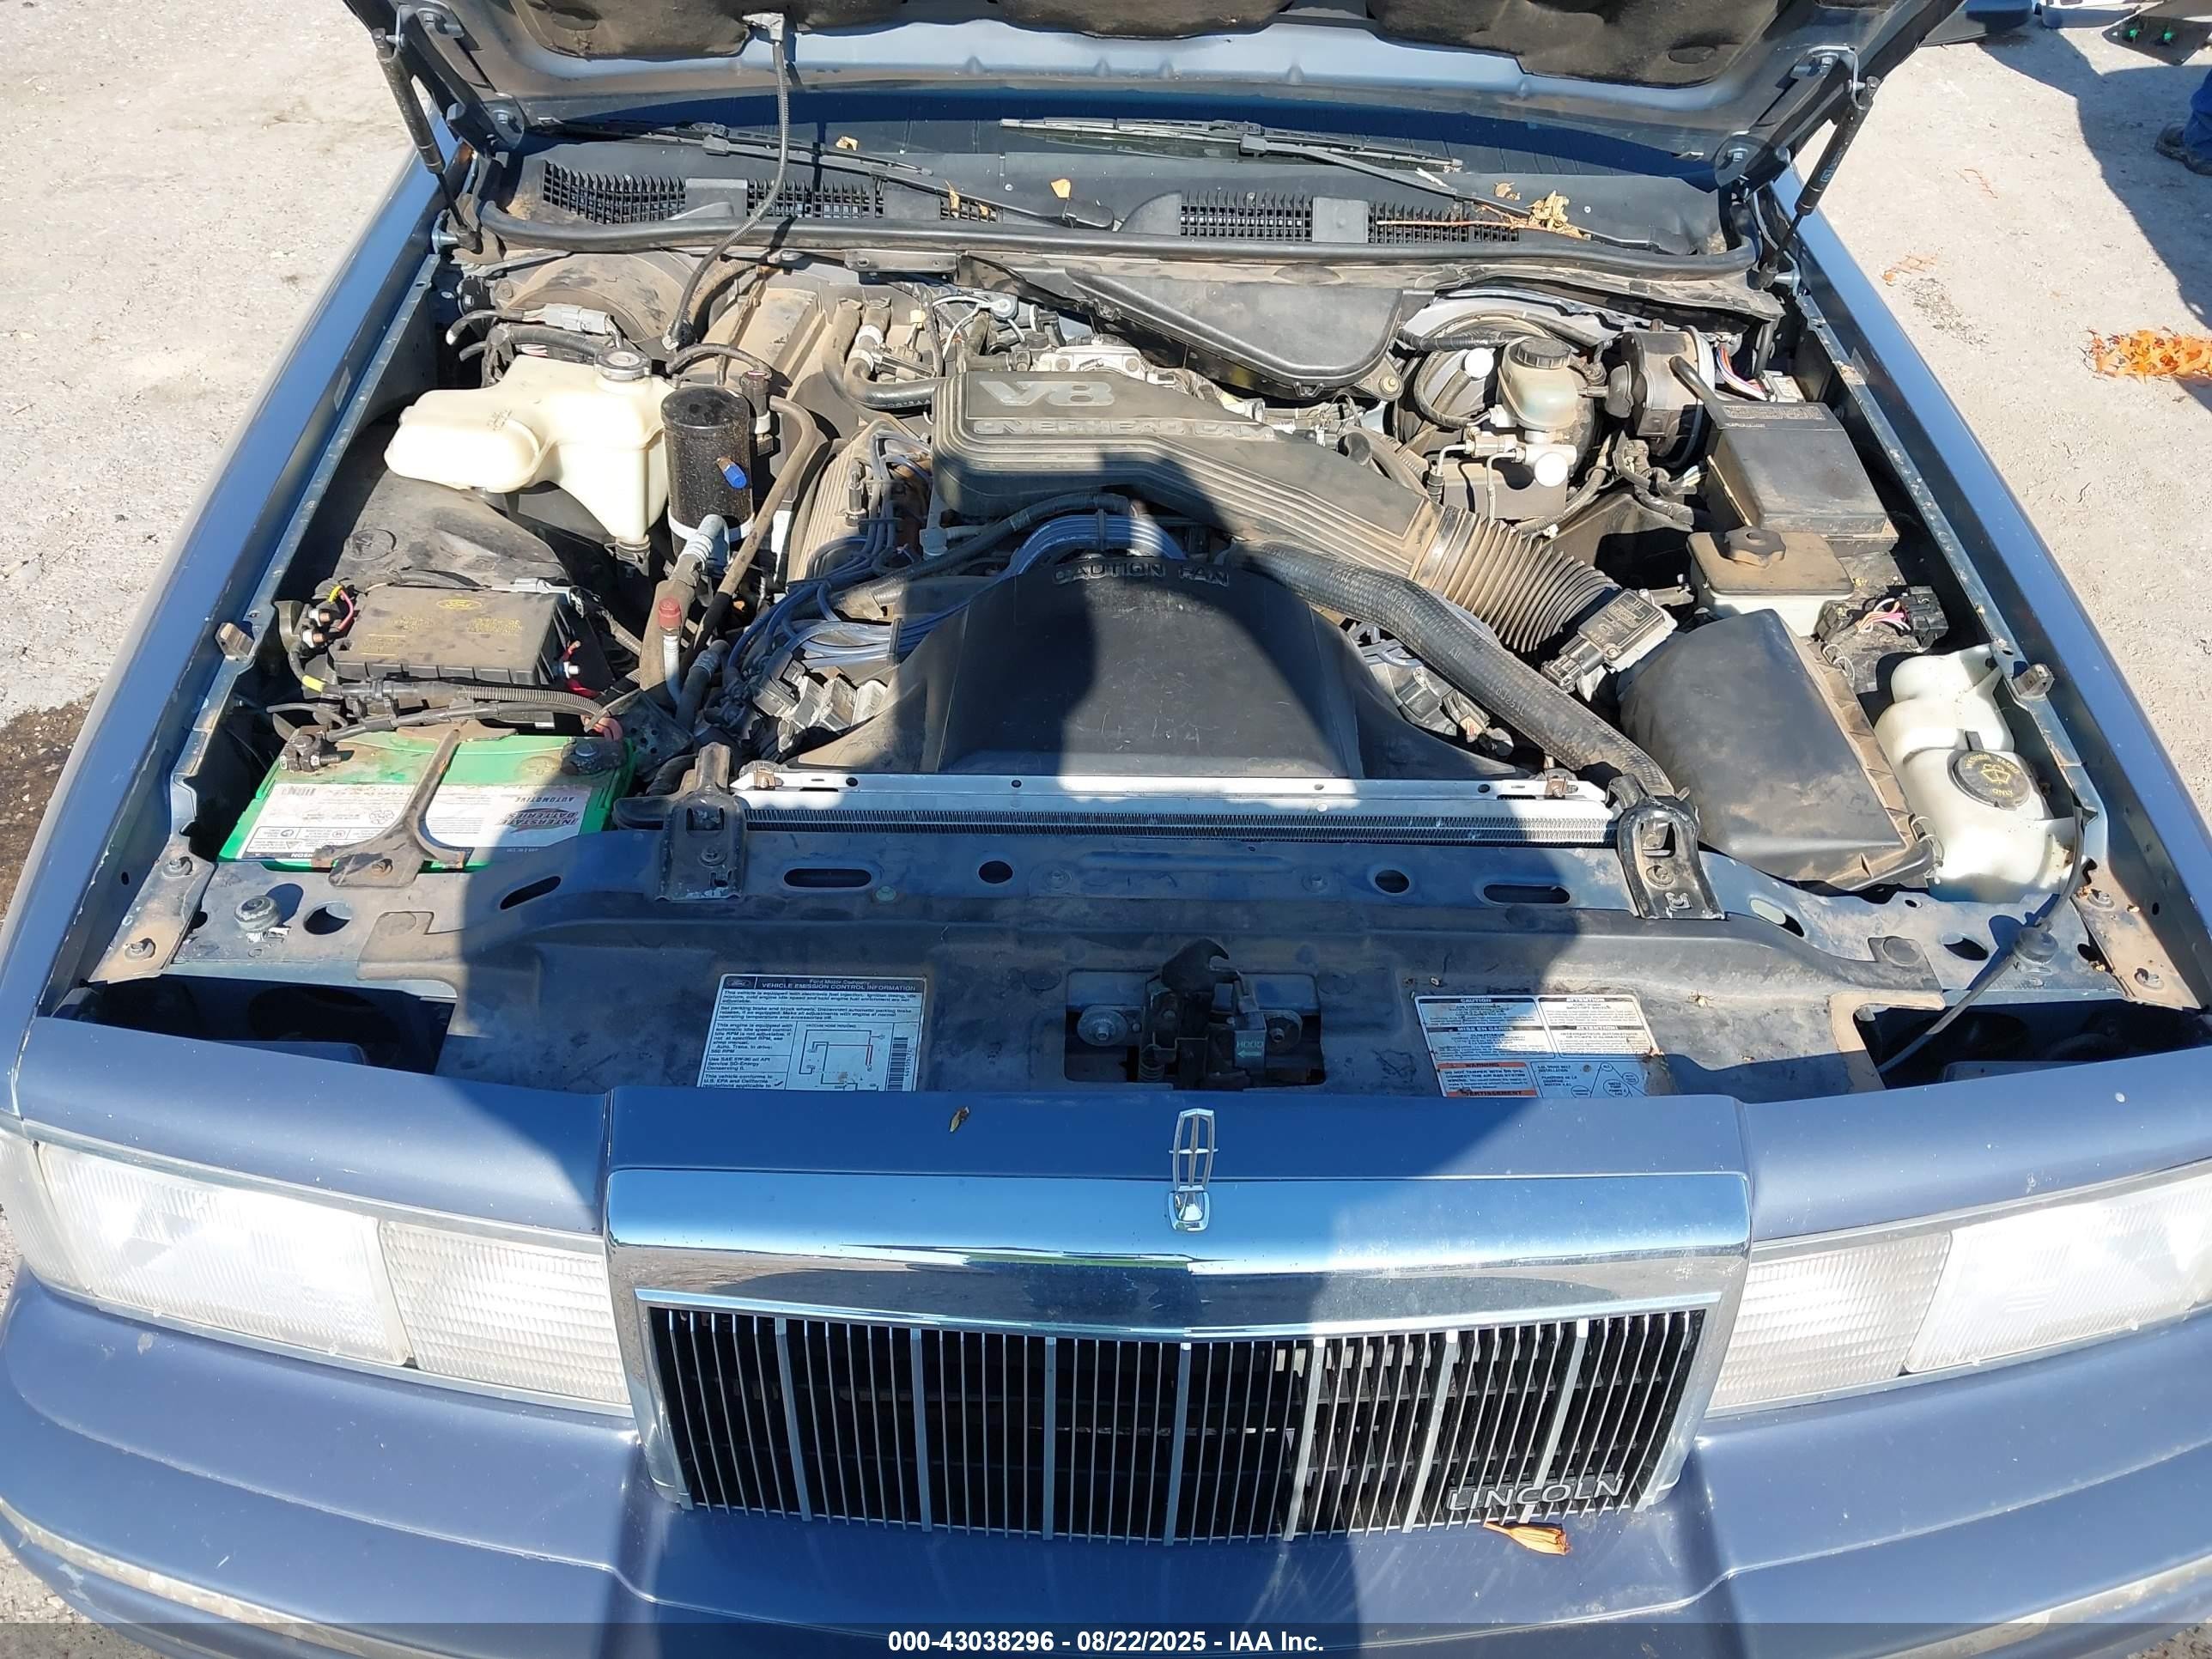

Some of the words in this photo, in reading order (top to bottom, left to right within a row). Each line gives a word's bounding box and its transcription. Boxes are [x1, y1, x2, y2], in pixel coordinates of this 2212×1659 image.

[978, 380, 1115, 406] V8
[1053, 562, 1166, 584] CAUTION
[1178, 565, 1230, 586] FAN
[1992, 788, 2013, 798] ONLY
[1449, 1477, 1624, 1510] LINCOLN
